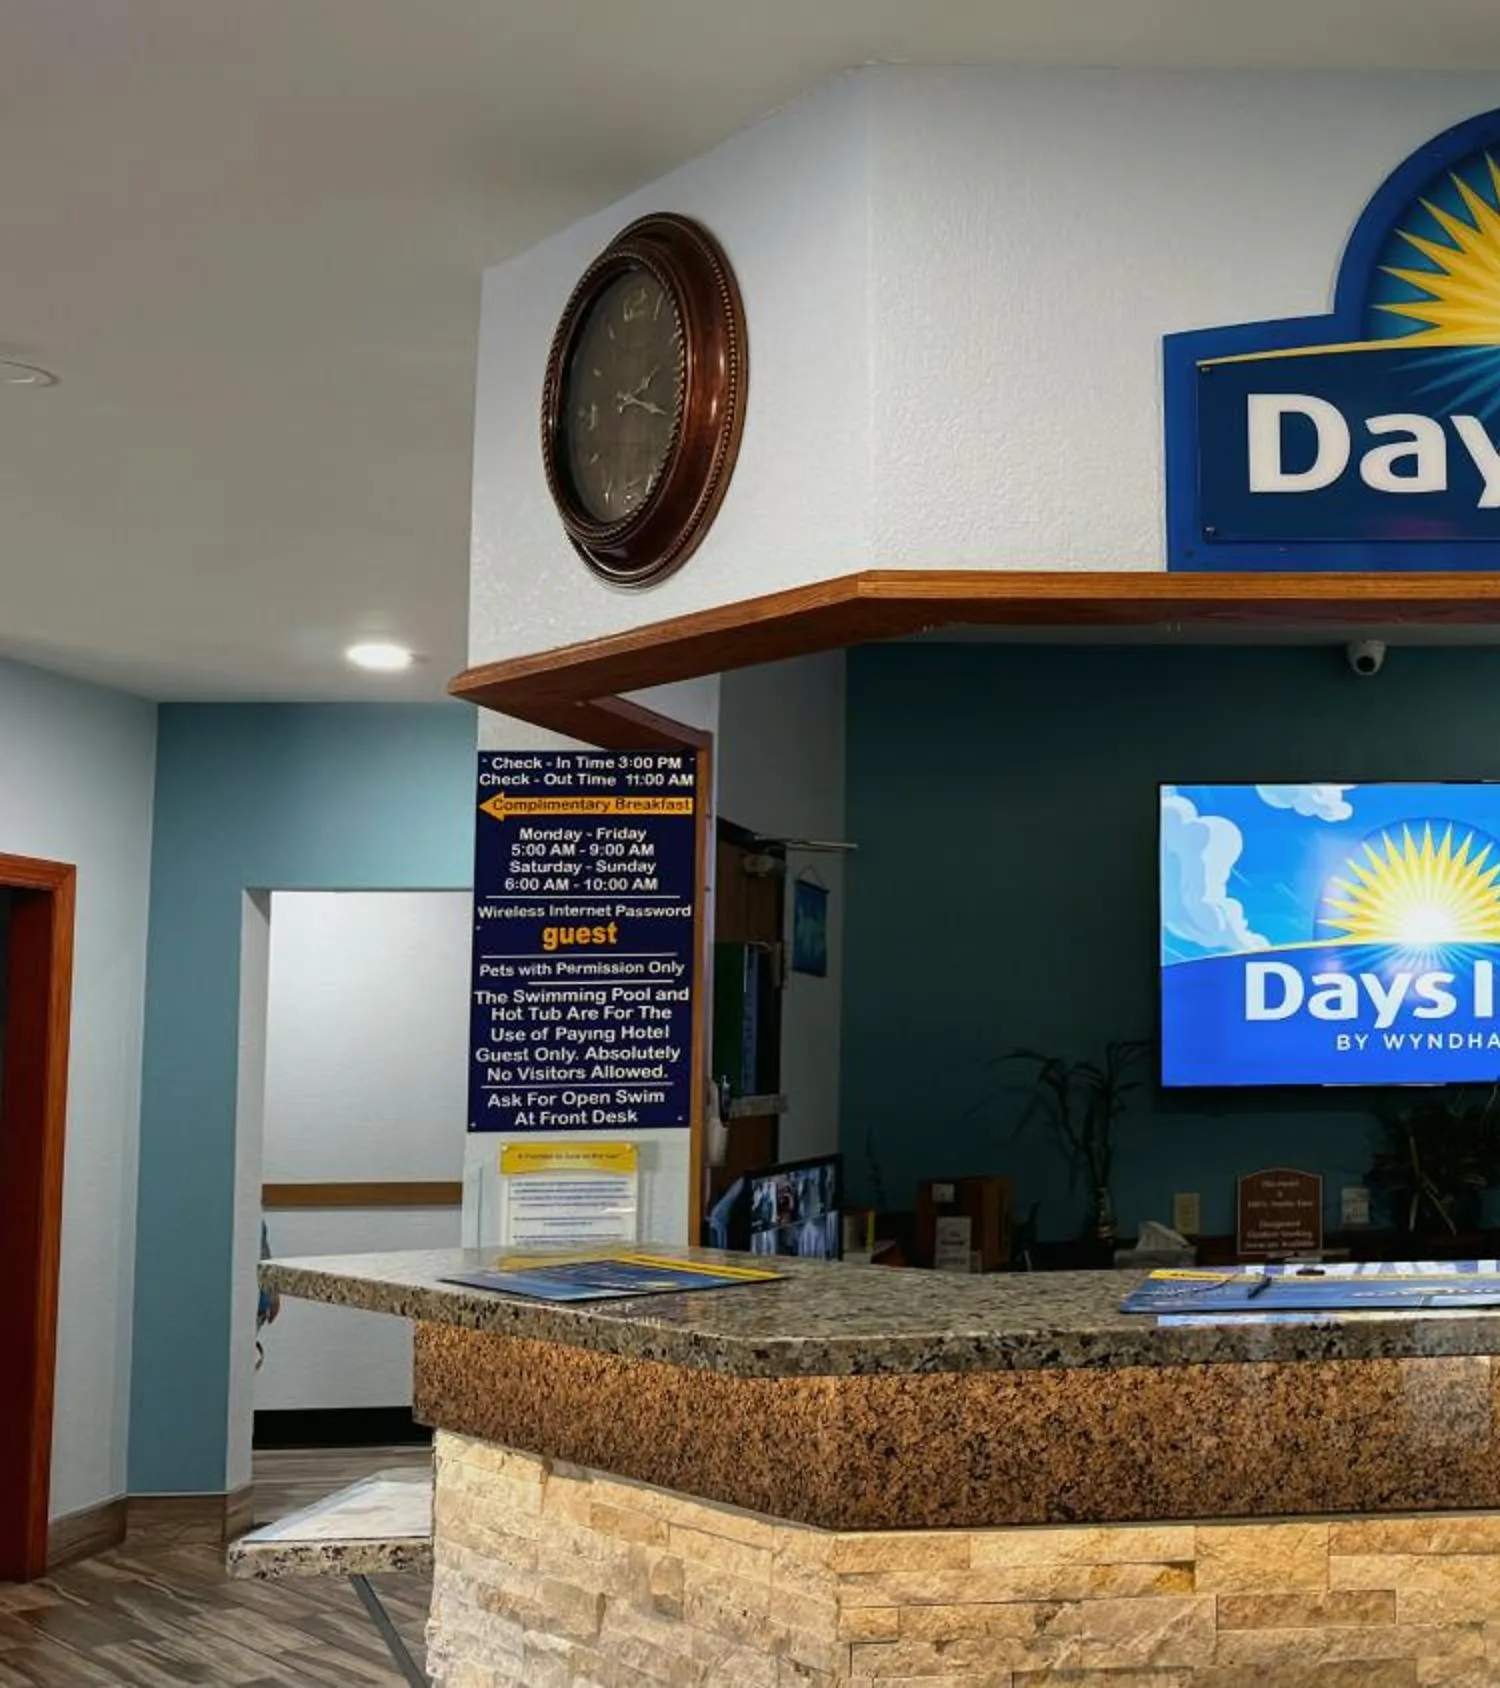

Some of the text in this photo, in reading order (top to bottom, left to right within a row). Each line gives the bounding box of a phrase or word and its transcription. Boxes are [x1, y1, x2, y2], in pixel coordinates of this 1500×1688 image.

[492, 757, 542, 769] Check
[556, 757, 571, 769] In
[576, 756, 614, 769] Time
[619, 756, 653, 769] 3:00
[658, 757, 682, 769] PM
[480, 774, 529, 786] Check
[544, 774, 572, 786] Out
[578, 774, 616, 786] Time
[626, 774, 664, 786] 11:00
[668, 774, 694, 786] AM
[493, 799, 690, 813] Complimentary Breakfast
[519, 828, 582, 842] Monday
[596, 828, 646, 842] Friday
[511, 844, 546, 856] 5:00
[550, 844, 575, 856] AM
[589, 844, 624, 856] 9:00
[629, 844, 654, 855] AM
[509, 861, 581, 875] Saturday
[596, 860, 656, 875] Sunday
[505, 879, 540, 891] 6:00
[543, 879, 569, 891] AM
[585, 878, 628, 891] 10:00
[632, 878, 658, 890] AM
[478, 905, 691, 919] Wireless Internet Password
[542, 922, 618, 950] guest
[480, 961, 685, 976] Pets with Permission Only
[474, 987, 689, 1005] The Swimming Pool and
[1244, 961, 1457, 1028] Days
[491, 1005, 672, 1021] Hot Tub Are For The
[491, 1025, 670, 1043] Use of Paying Hotel
[1337, 1033, 1369, 1051] BY
[476, 1048, 529, 1063] Guest
[585, 1046, 681, 1063] Absolutely
[487, 1064, 668, 1082] No Visitors Allowed.
[487, 1089, 665, 1107] Ask For Open Swim
[514, 1109, 638, 1126] At Front Desk
